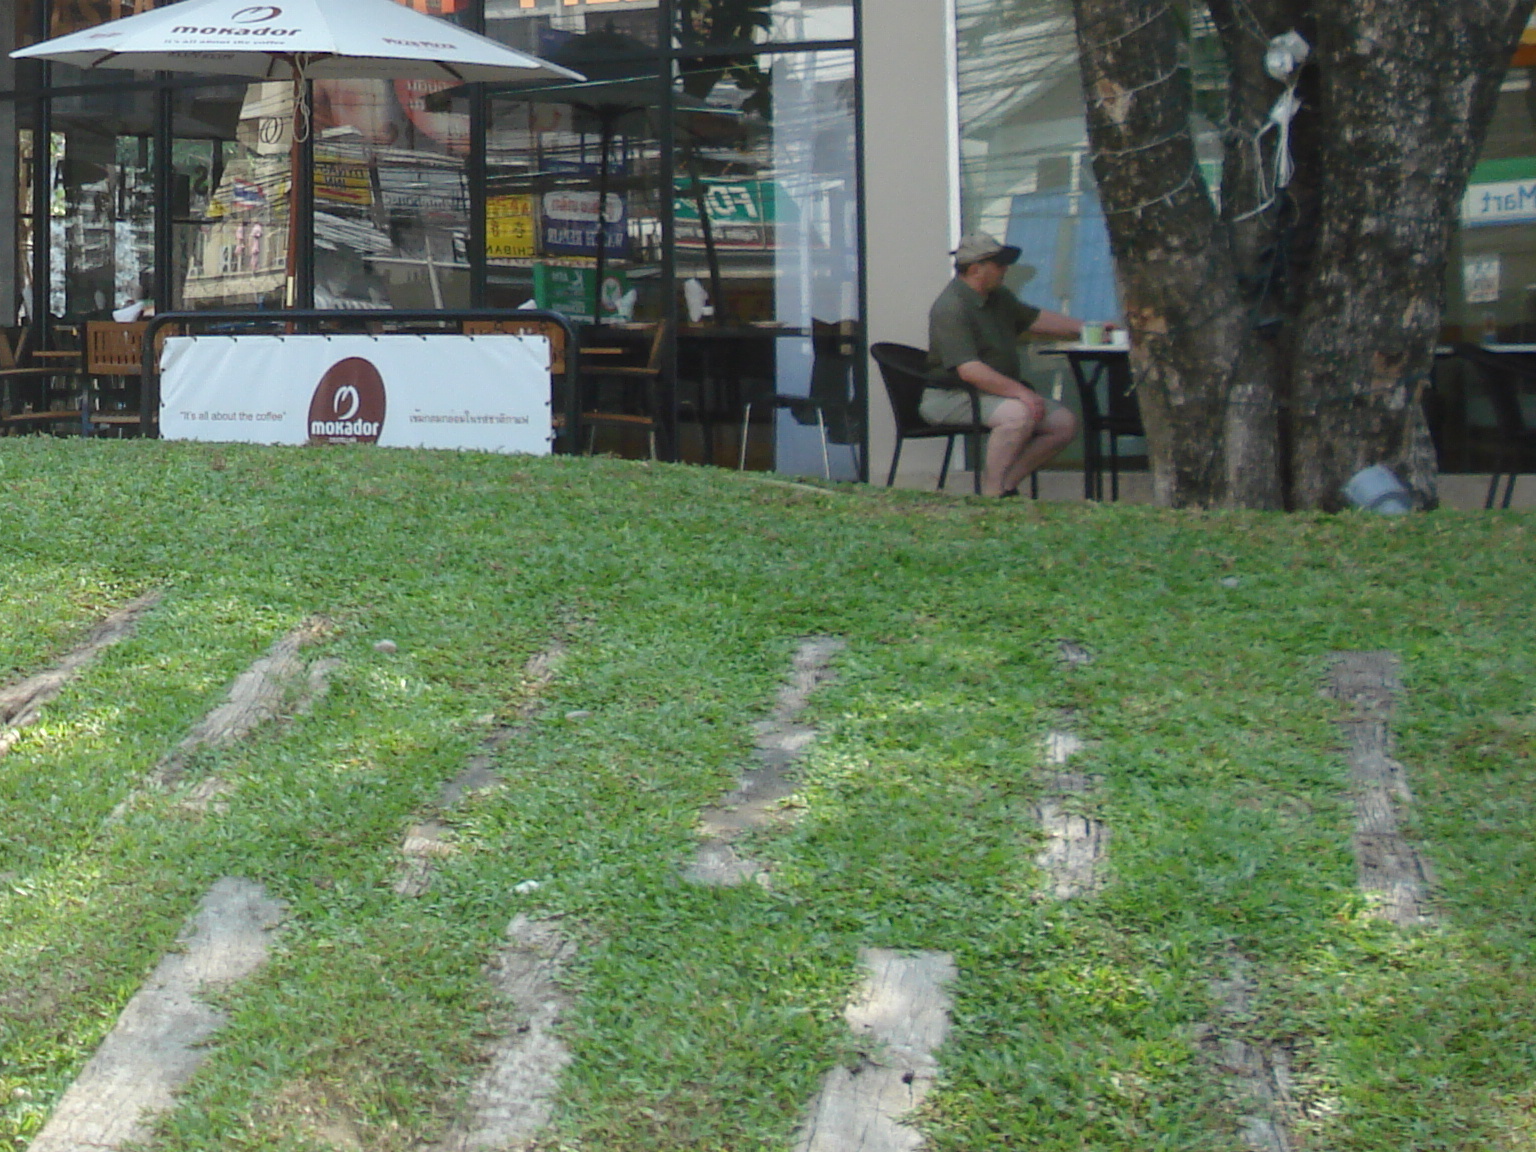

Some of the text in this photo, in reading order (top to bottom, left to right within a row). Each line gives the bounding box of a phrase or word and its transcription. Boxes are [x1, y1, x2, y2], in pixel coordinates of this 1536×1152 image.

[198, 410, 209, 422] all
[210, 410, 237, 422] about
[239, 410, 254, 422] the
